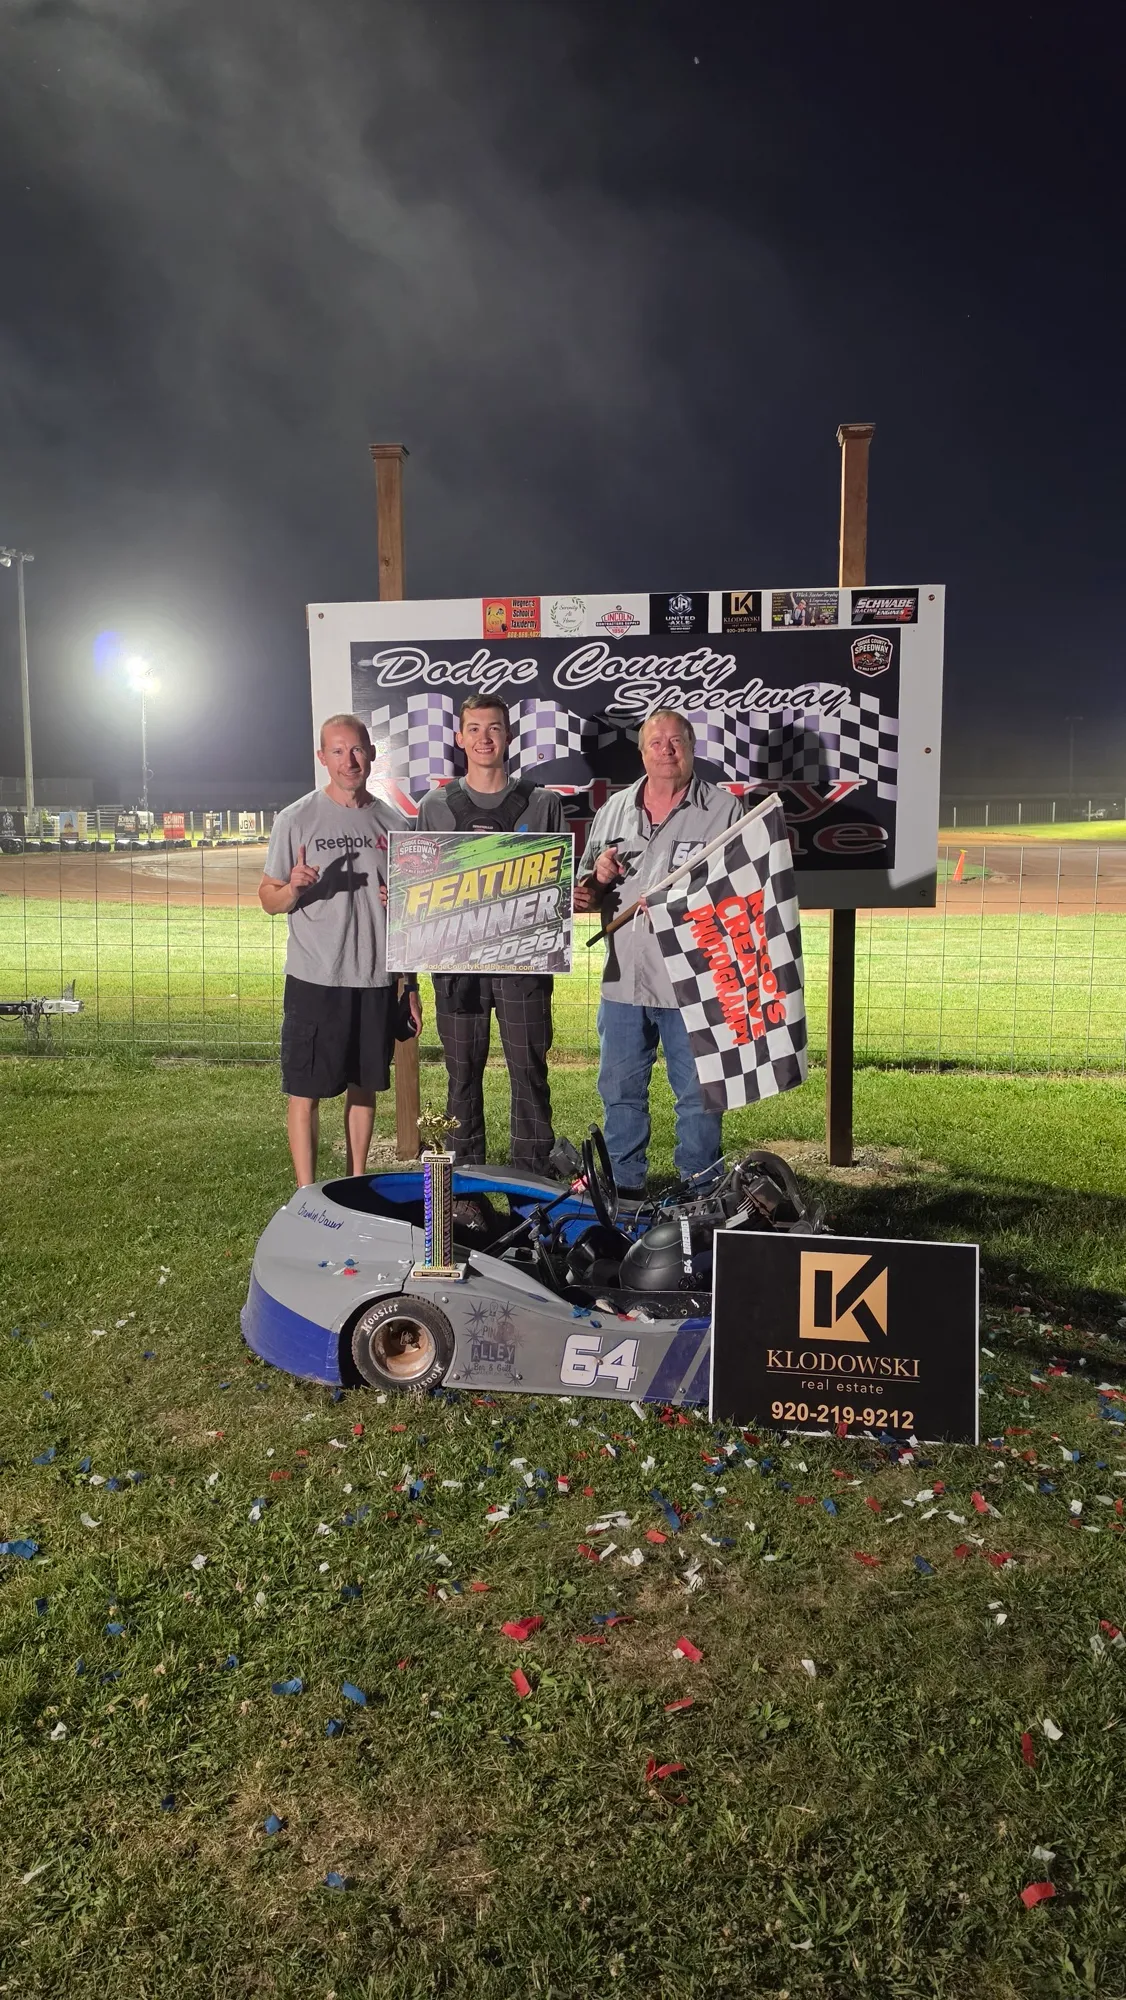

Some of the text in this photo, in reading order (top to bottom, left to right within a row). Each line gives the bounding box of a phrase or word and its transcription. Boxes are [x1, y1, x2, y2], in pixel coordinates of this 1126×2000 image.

[512, 609, 536, 618] School of
[857, 598, 914, 608] SCHWABE
[511, 620, 537, 629] Taxidermy
[604, 612, 632, 621] LINCOLN
[854, 644, 889, 654] SPEEDWAY
[871, 638, 887, 646] COUNTY
[372, 641, 737, 694] Dodge County
[604, 678, 851, 718] Speedway
[315, 835, 373, 851] Reebok
[400, 845, 437, 855] SPEEDWAY
[404, 847, 562, 921] FEATURE
[407, 886, 559, 961] WINNER
[479, 929, 559, 964] 2026
[747, 888, 787, 1024] ROCCO'S
[715, 896, 766, 1041] CREATIVE
[684, 1259, 692, 1273] 64
[361, 1304, 398, 1335] Hoosier
[471, 1342, 515, 1363] ALLEY
[560, 1333, 640, 1392] 64
[767, 1349, 920, 1377] KLODOWSKI
[801, 1379, 884, 1394] real estate
[771, 1401, 914, 1430] 920-219-9212
